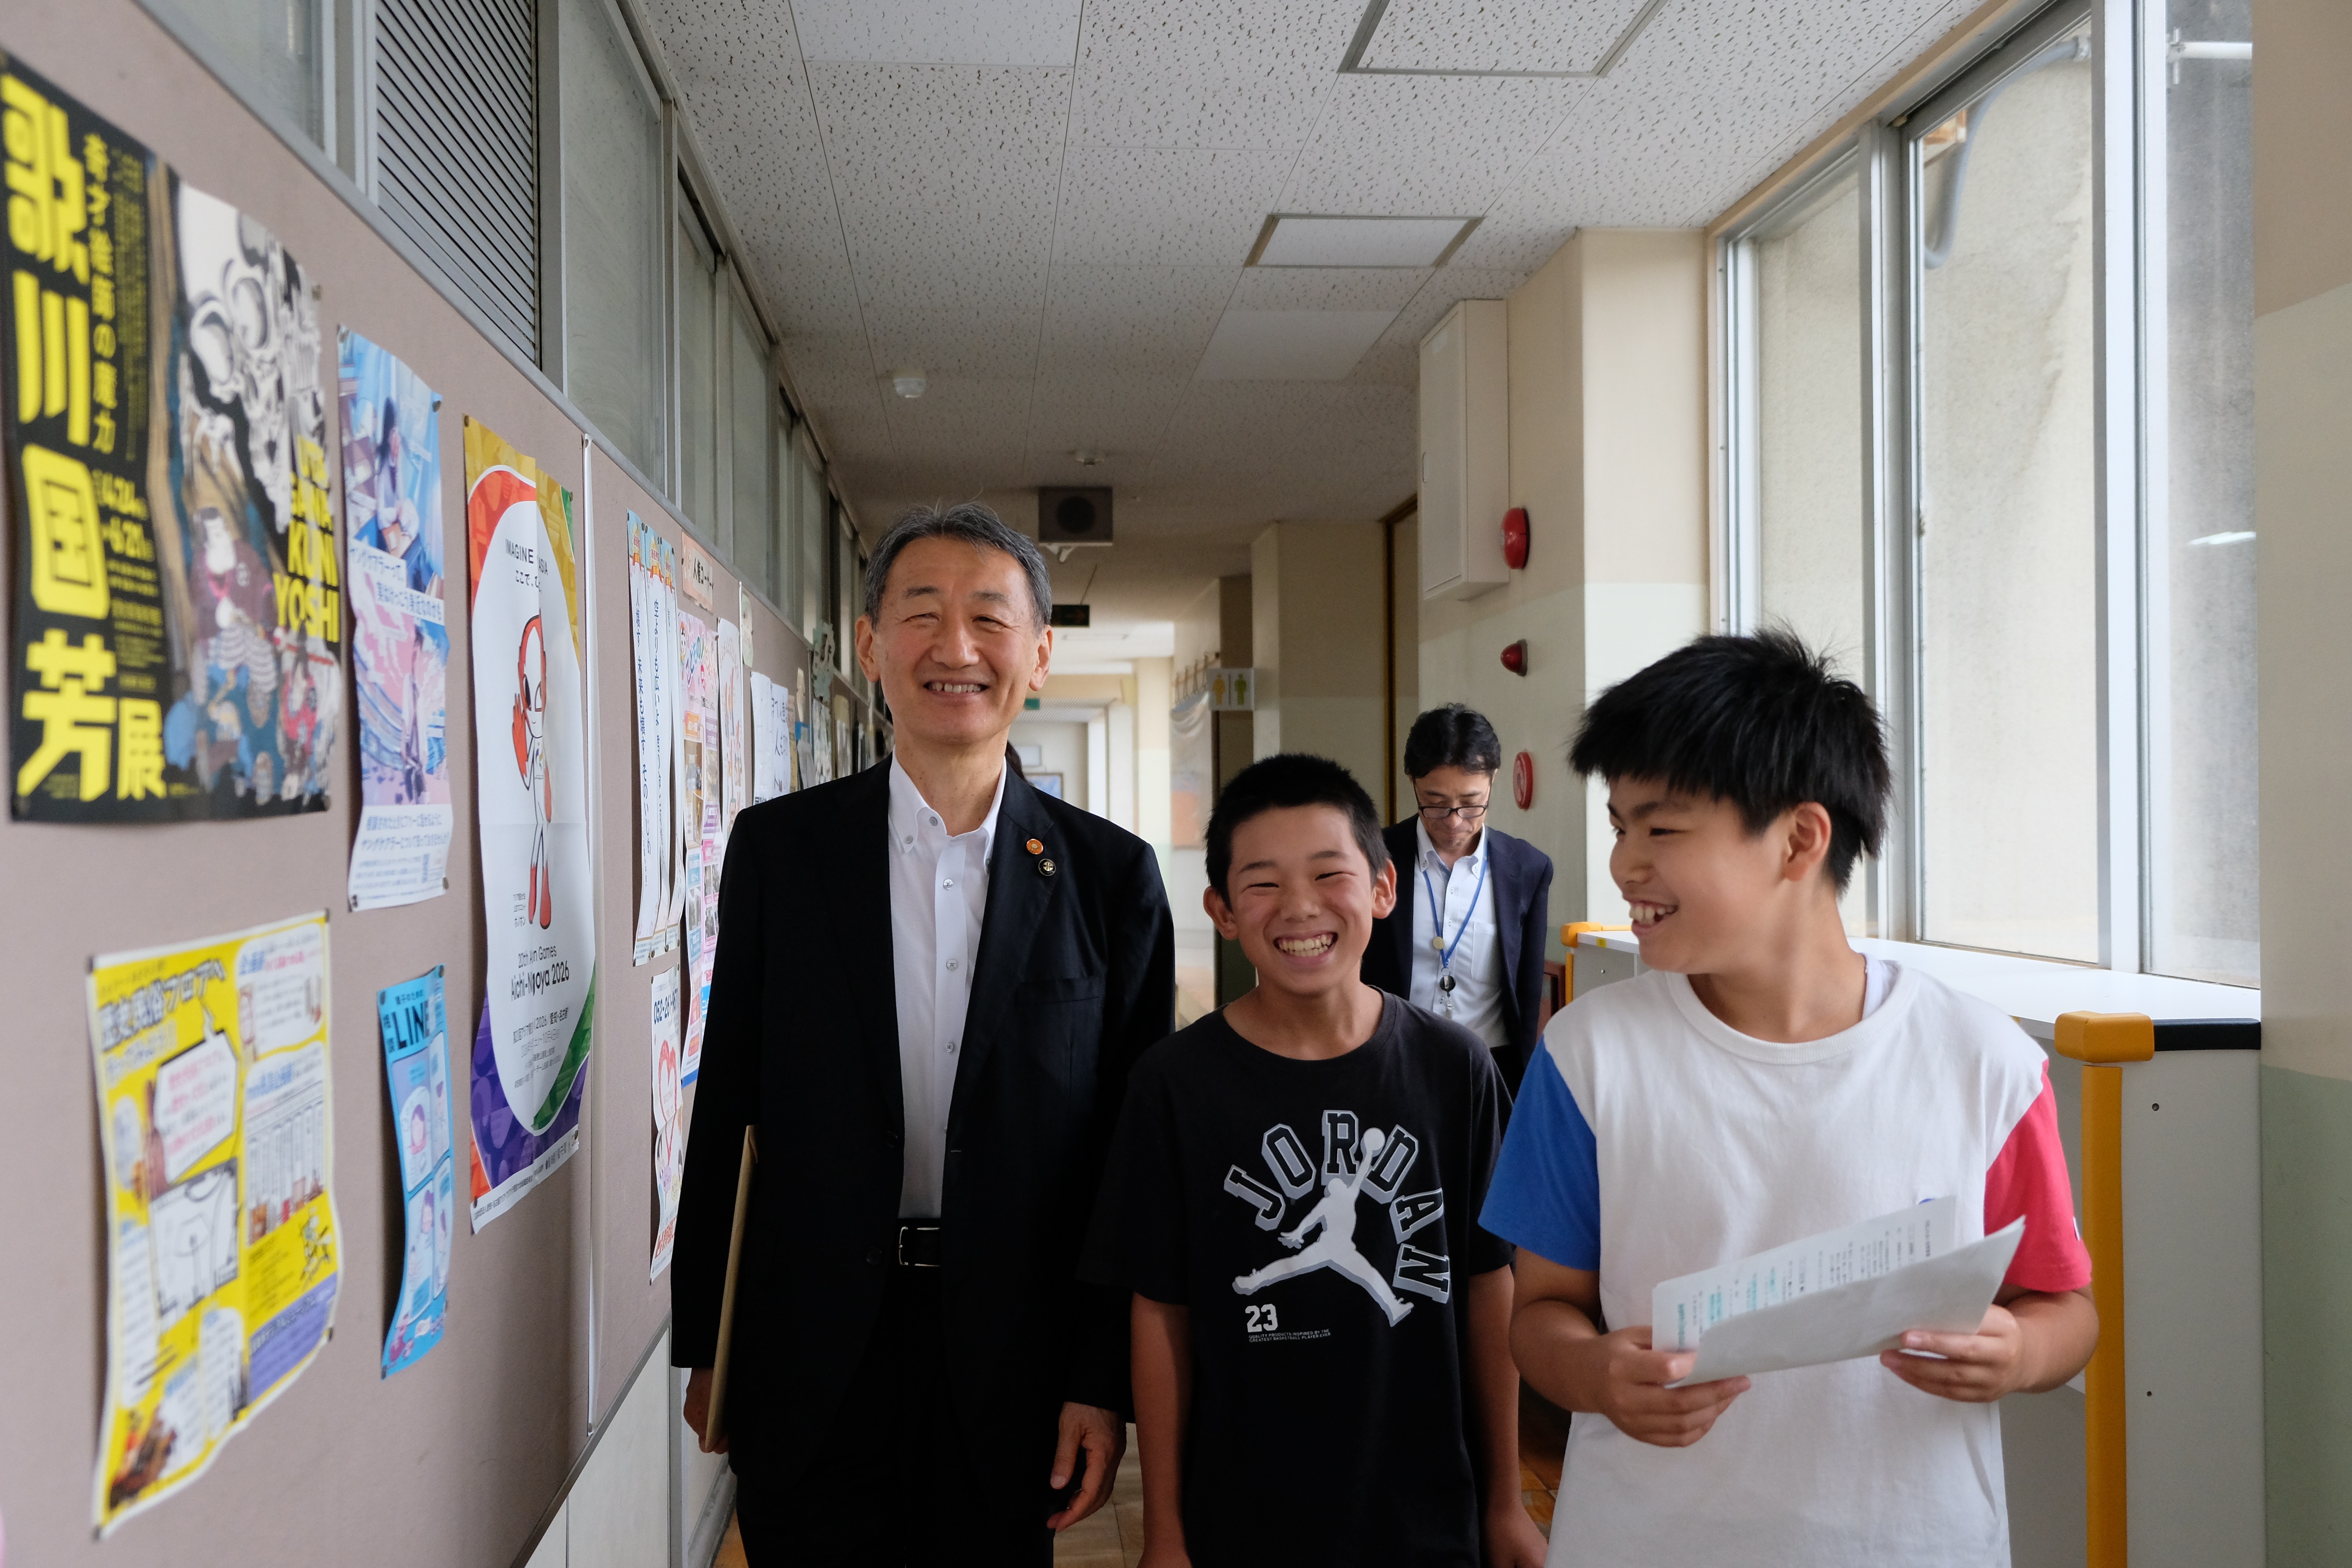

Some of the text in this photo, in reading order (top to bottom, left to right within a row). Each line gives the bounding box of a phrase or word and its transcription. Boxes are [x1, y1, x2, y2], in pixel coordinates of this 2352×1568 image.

[505, 538, 534, 564] IMAGINE
[272, 571, 340, 643] YOSHI
[538, 946, 557, 961] Games
[552, 960, 570, 985] 2026
[1223, 1109, 1451, 1304] JORDAN
[1245, 1303, 1278, 1333] 23
